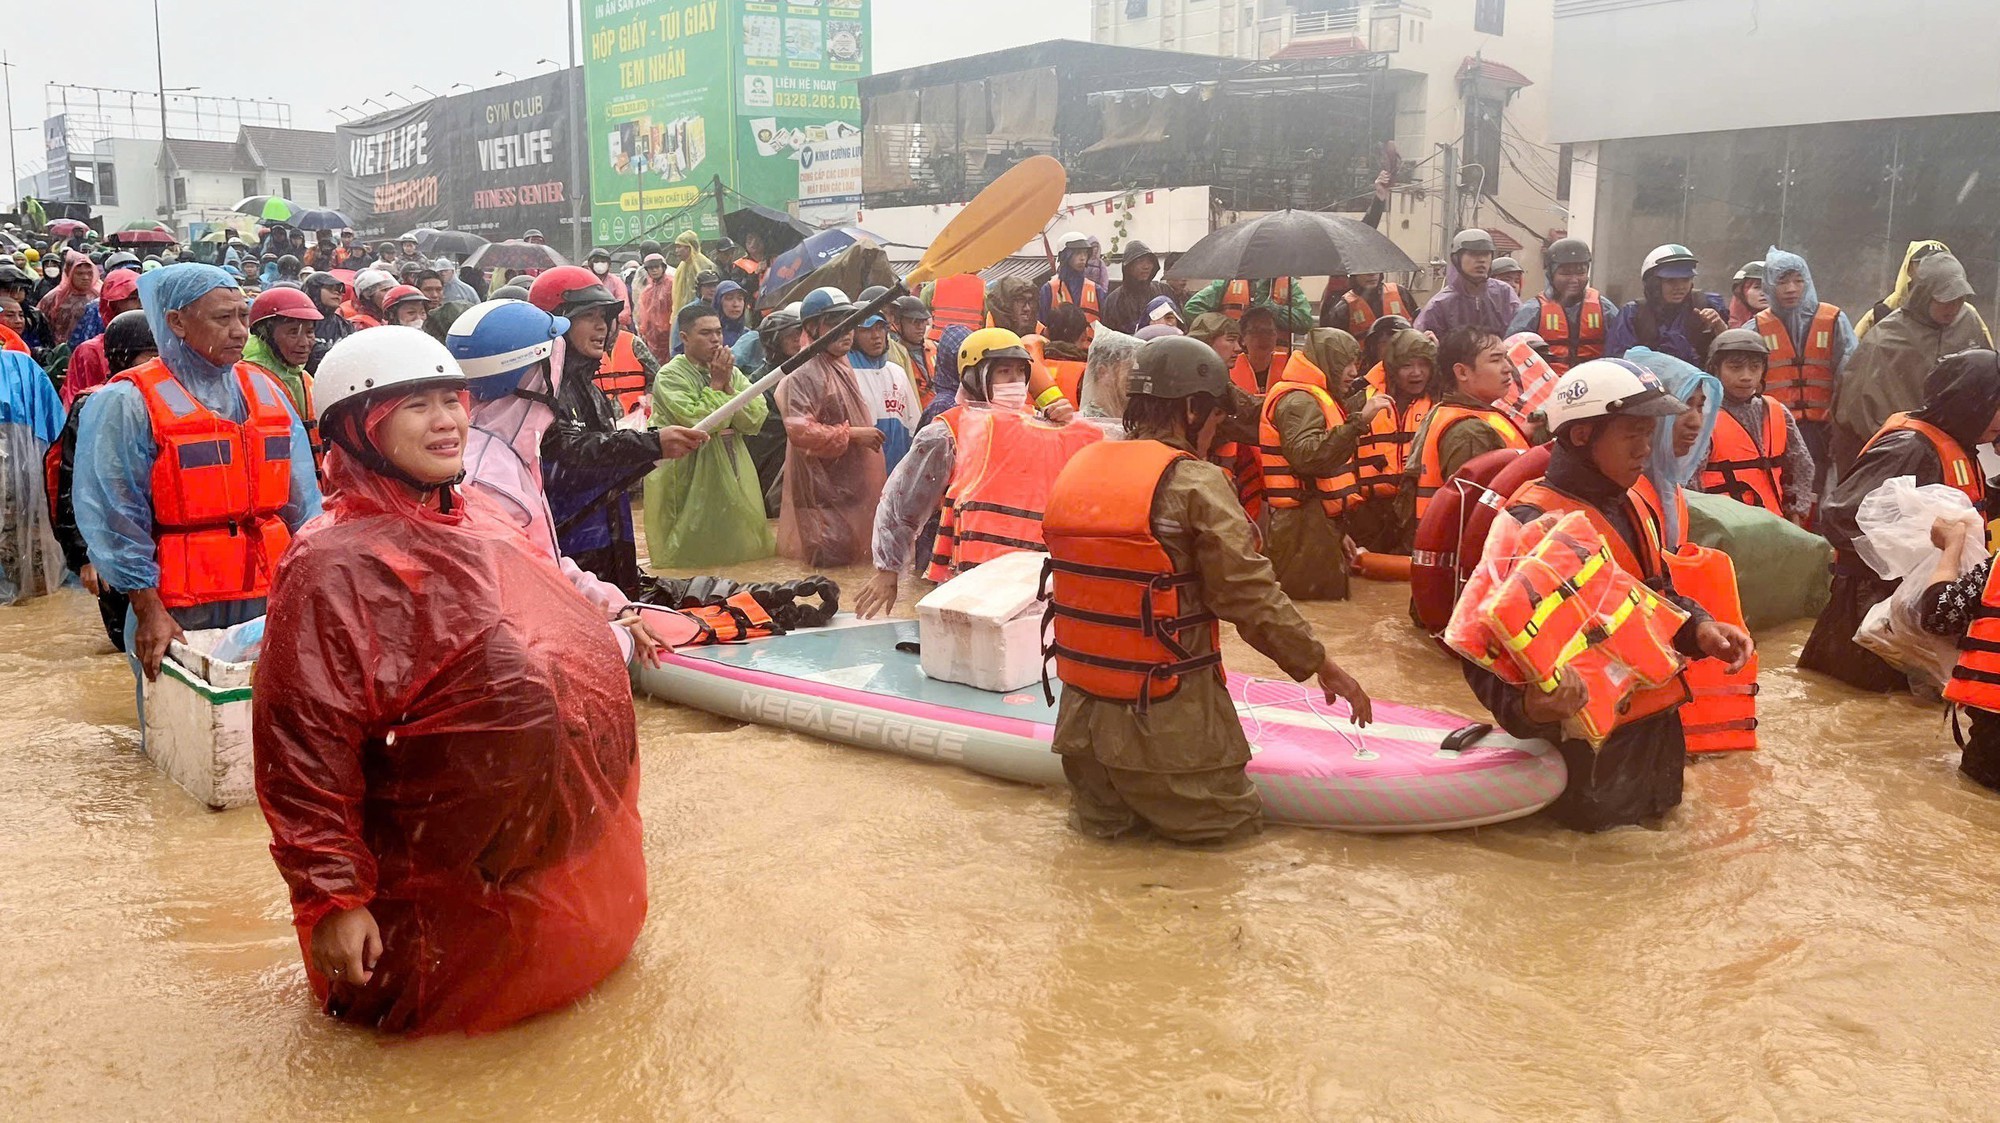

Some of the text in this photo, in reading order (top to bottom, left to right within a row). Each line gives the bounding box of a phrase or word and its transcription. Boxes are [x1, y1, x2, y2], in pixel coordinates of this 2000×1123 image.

[592, 25, 615, 63] HỘP
[619, 12, 647, 53] GIẤY
[659, 5, 680, 42] TÚI
[619, 58, 645, 89] TEM
[775, 75, 837, 93] LIÊN HỆ NGAY
[486, 95, 544, 124] GYM CLUB
[350, 121, 428, 178] VIETLIFE
[478, 128, 553, 171] VIETLIFE
[374, 175, 438, 214] SUPERGYM
[474, 181, 565, 209] FITNESS CENTER
[741, 690, 969, 760] MSEASFREE
